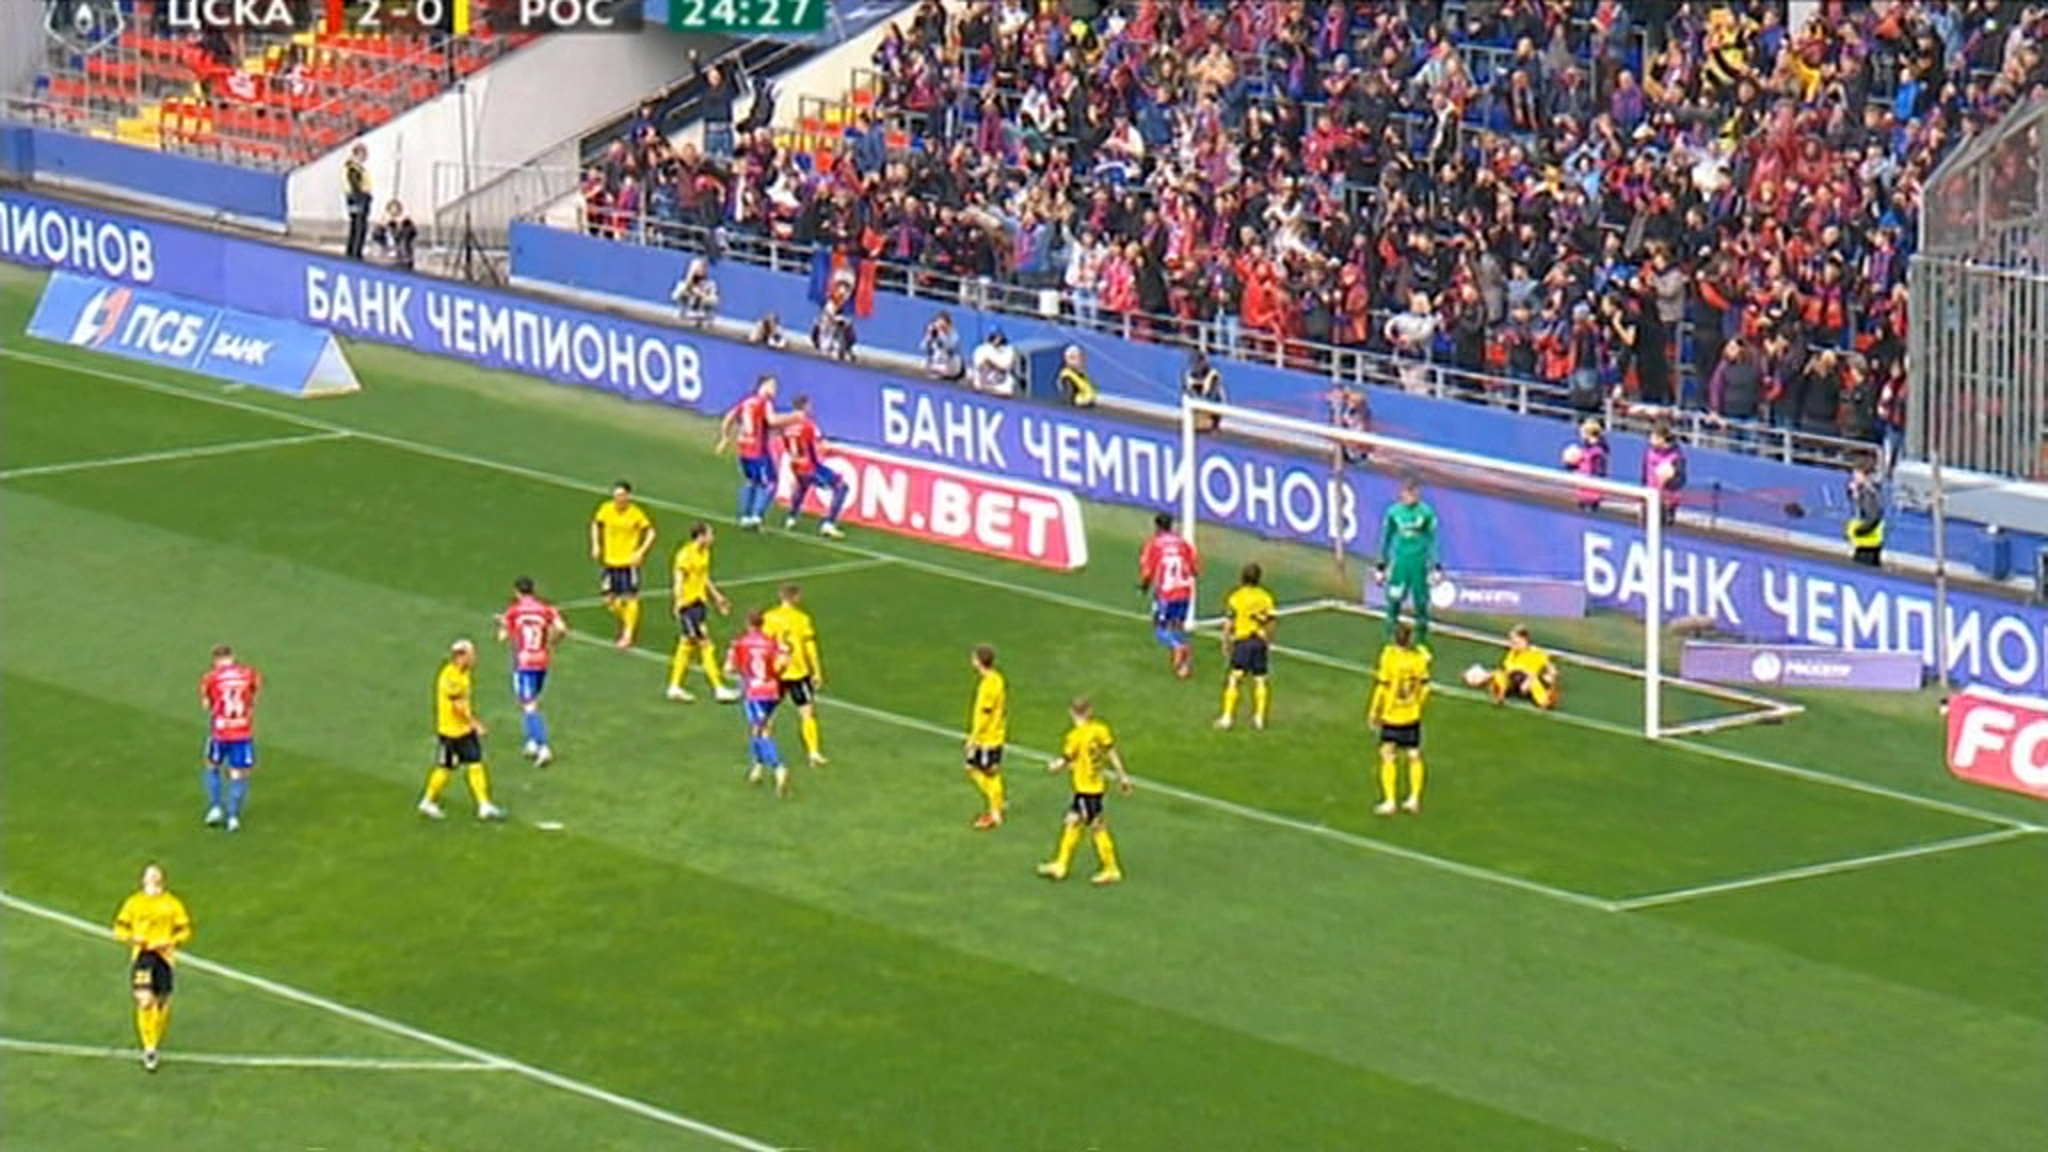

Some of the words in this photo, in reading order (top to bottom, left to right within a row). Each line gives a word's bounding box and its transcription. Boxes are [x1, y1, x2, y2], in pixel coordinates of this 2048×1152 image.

[120, 303, 204, 358] ПСБ
[305, 266, 412, 339] БАНК
[426, 292, 701, 401] ЧЕМПИОНОВ
[881, 388, 1006, 468] БАНК
[1022, 416, 1358, 542] ЧЕМПИОНОВ
[1584, 531, 1741, 624] БАНК
[1763, 567, 2048, 686] ЧЕМПИО
